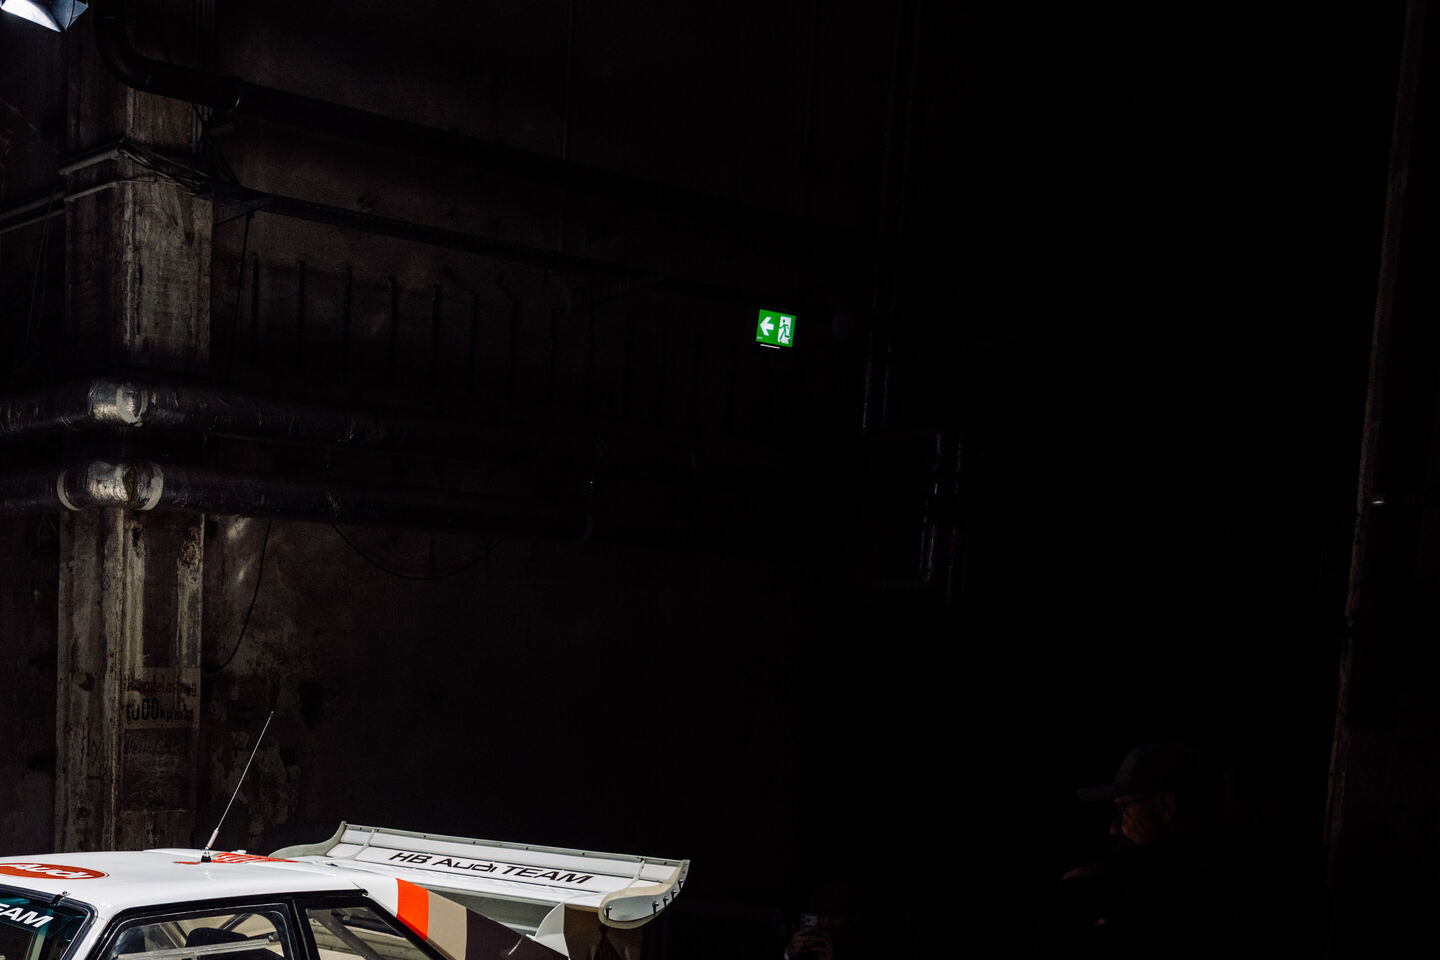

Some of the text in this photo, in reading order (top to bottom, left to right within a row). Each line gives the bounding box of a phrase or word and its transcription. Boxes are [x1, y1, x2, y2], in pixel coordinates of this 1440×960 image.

[389, 853, 594, 884] HB Audi TEAM
